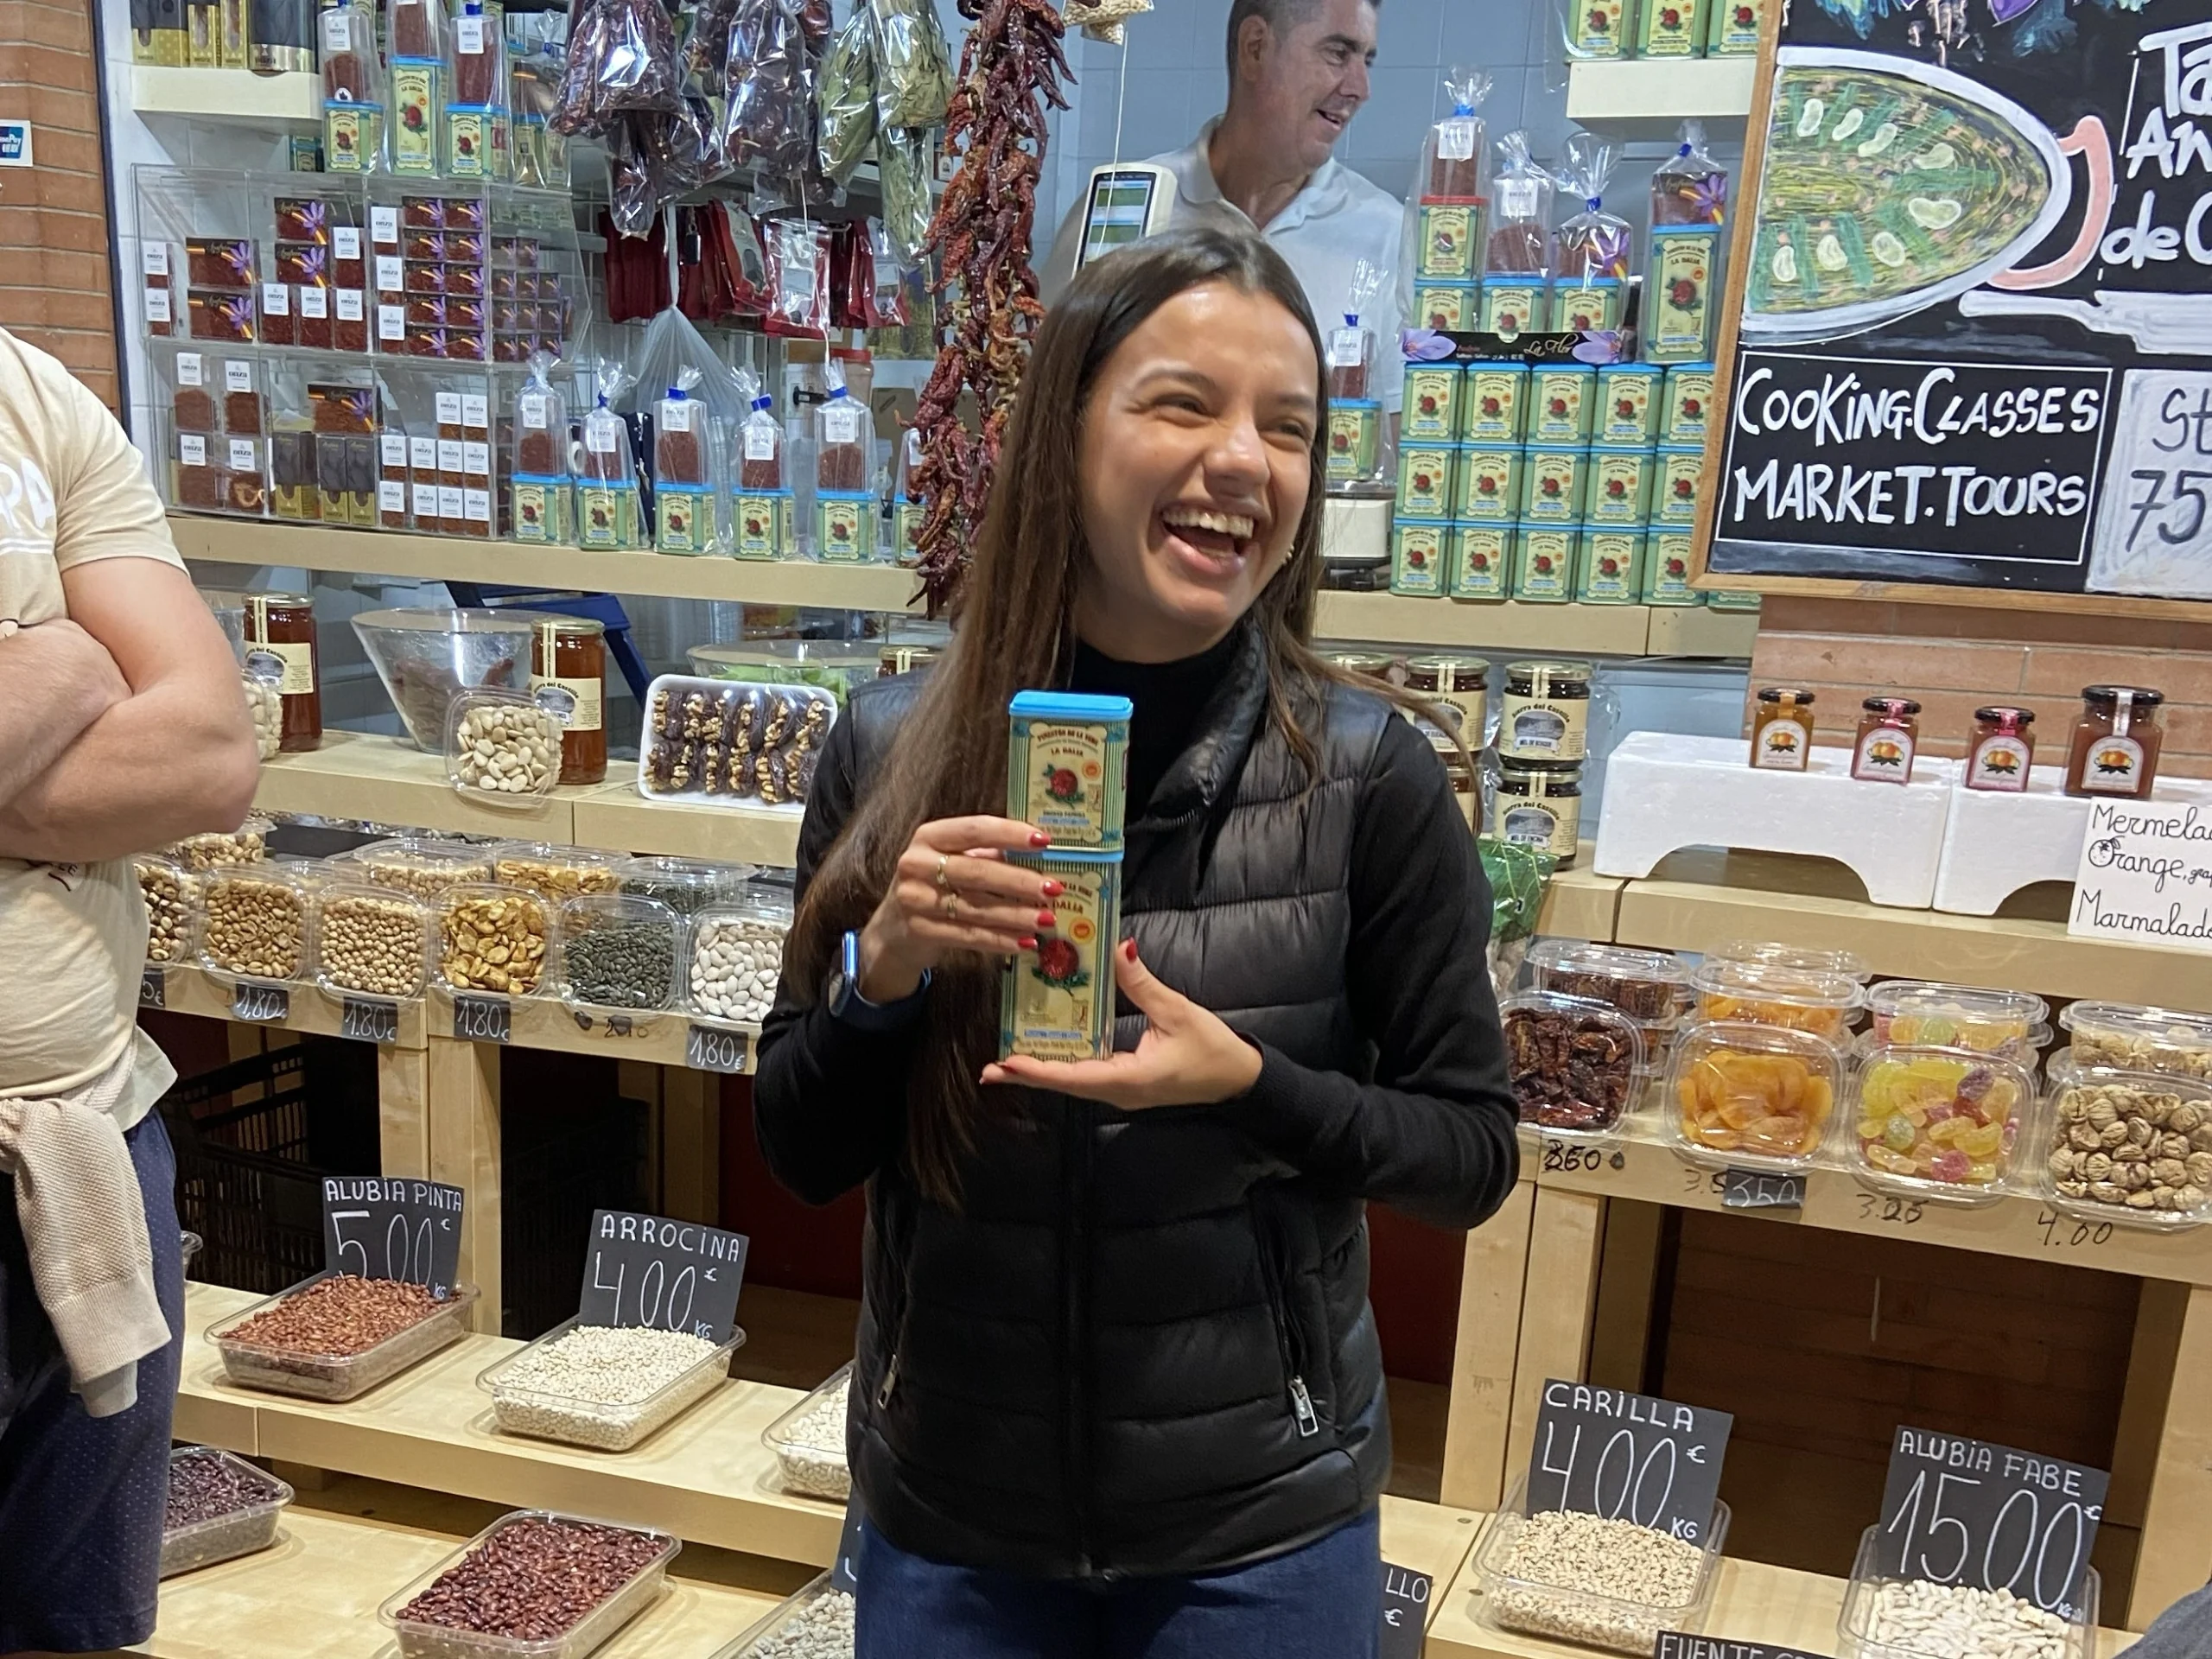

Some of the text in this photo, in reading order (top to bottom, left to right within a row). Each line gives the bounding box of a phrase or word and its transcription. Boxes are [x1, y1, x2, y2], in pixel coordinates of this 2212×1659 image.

[2100, 189, 2181, 270] de
[1942, 466, 2087, 527] TOURS
[1051, 746, 1060, 756] LA
[2092, 804, 2212, 841] Mermela
[325, 1177, 462, 1212] ALUBIA PINTA
[601, 1213, 740, 1263] ARROCINA
[2037, 1211, 2114, 1247] 4.00
[694, 1319, 714, 1340] KG
[1545, 1383, 1694, 1433] CARILLA
[1899, 1430, 2082, 1497] ALUBIA FABE
[1670, 1516, 1699, 1540] KG
